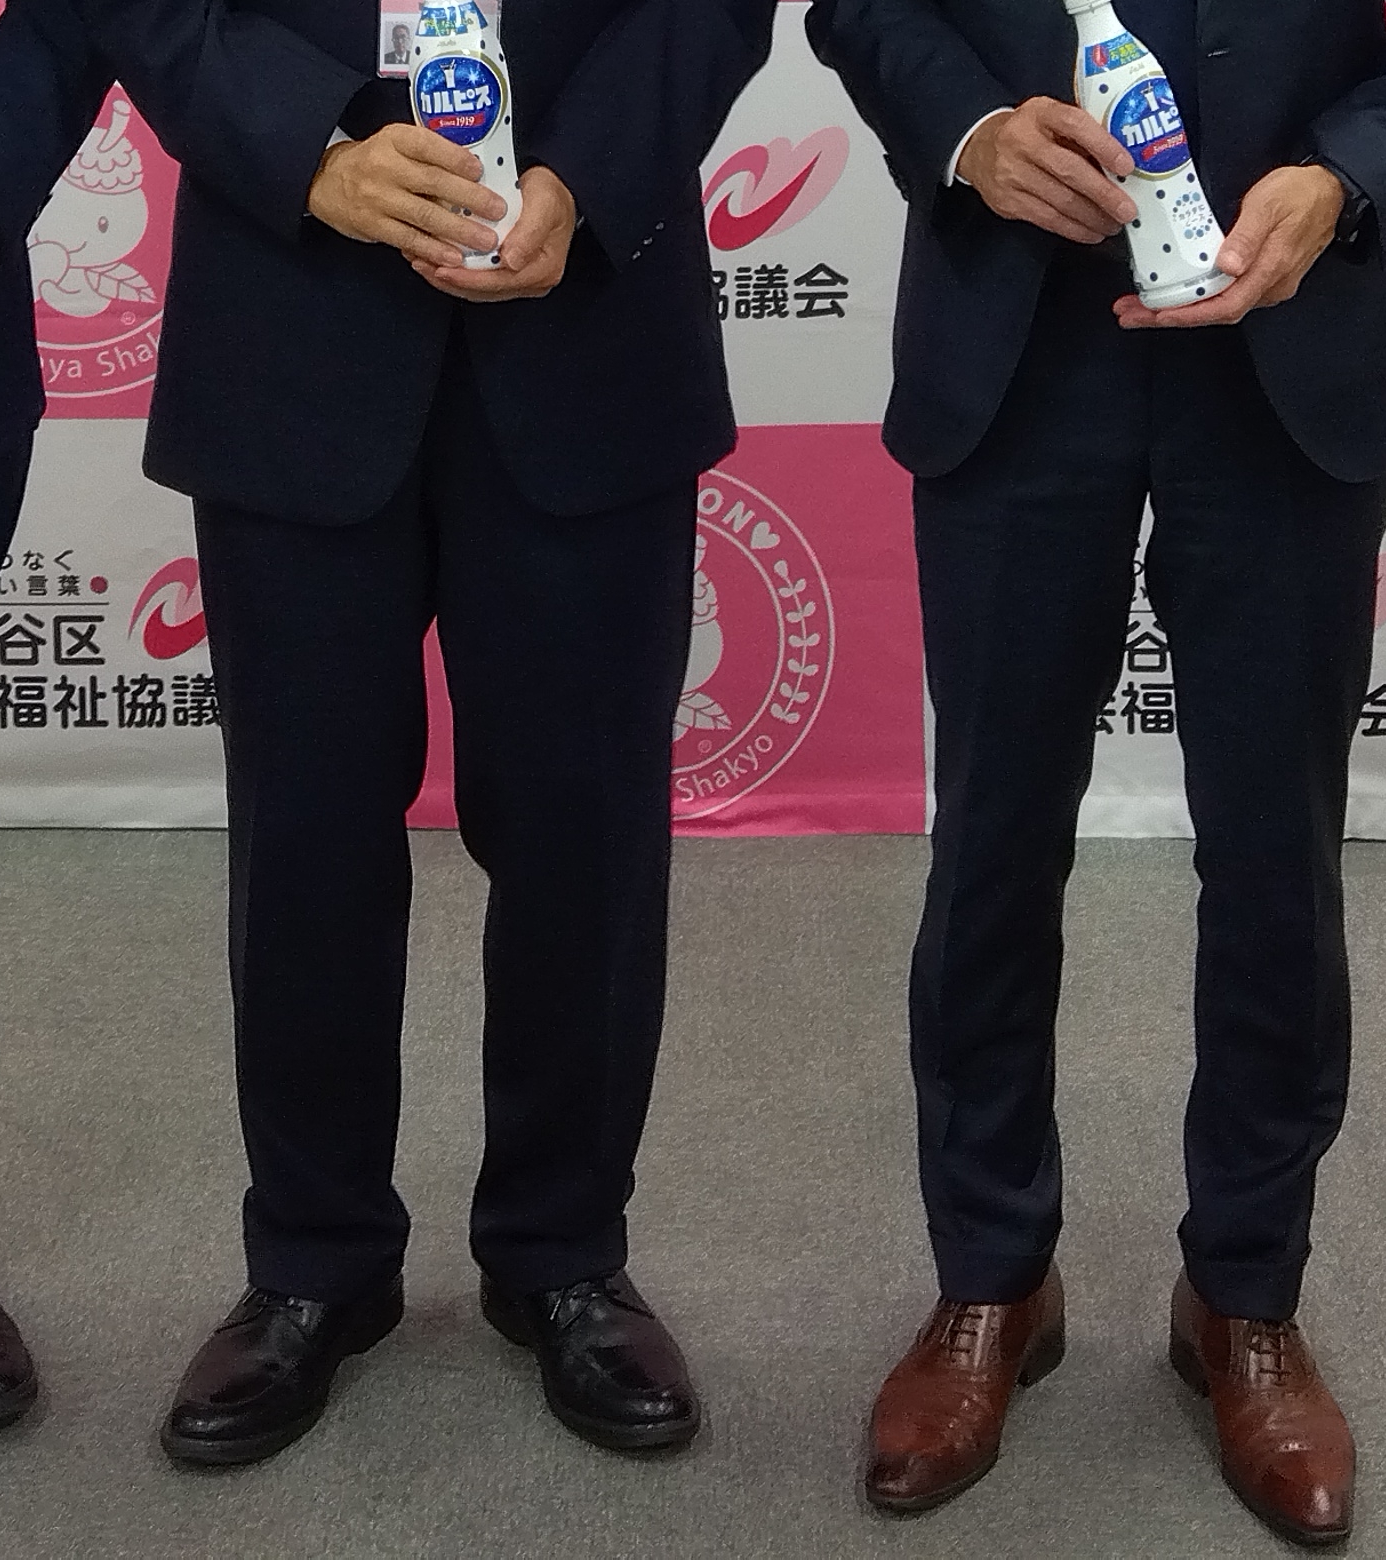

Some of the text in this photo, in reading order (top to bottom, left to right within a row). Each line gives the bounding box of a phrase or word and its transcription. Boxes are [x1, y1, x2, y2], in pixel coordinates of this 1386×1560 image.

[420, 84, 492, 114] カルピス
[674, 732, 774, 804] Shakyo
